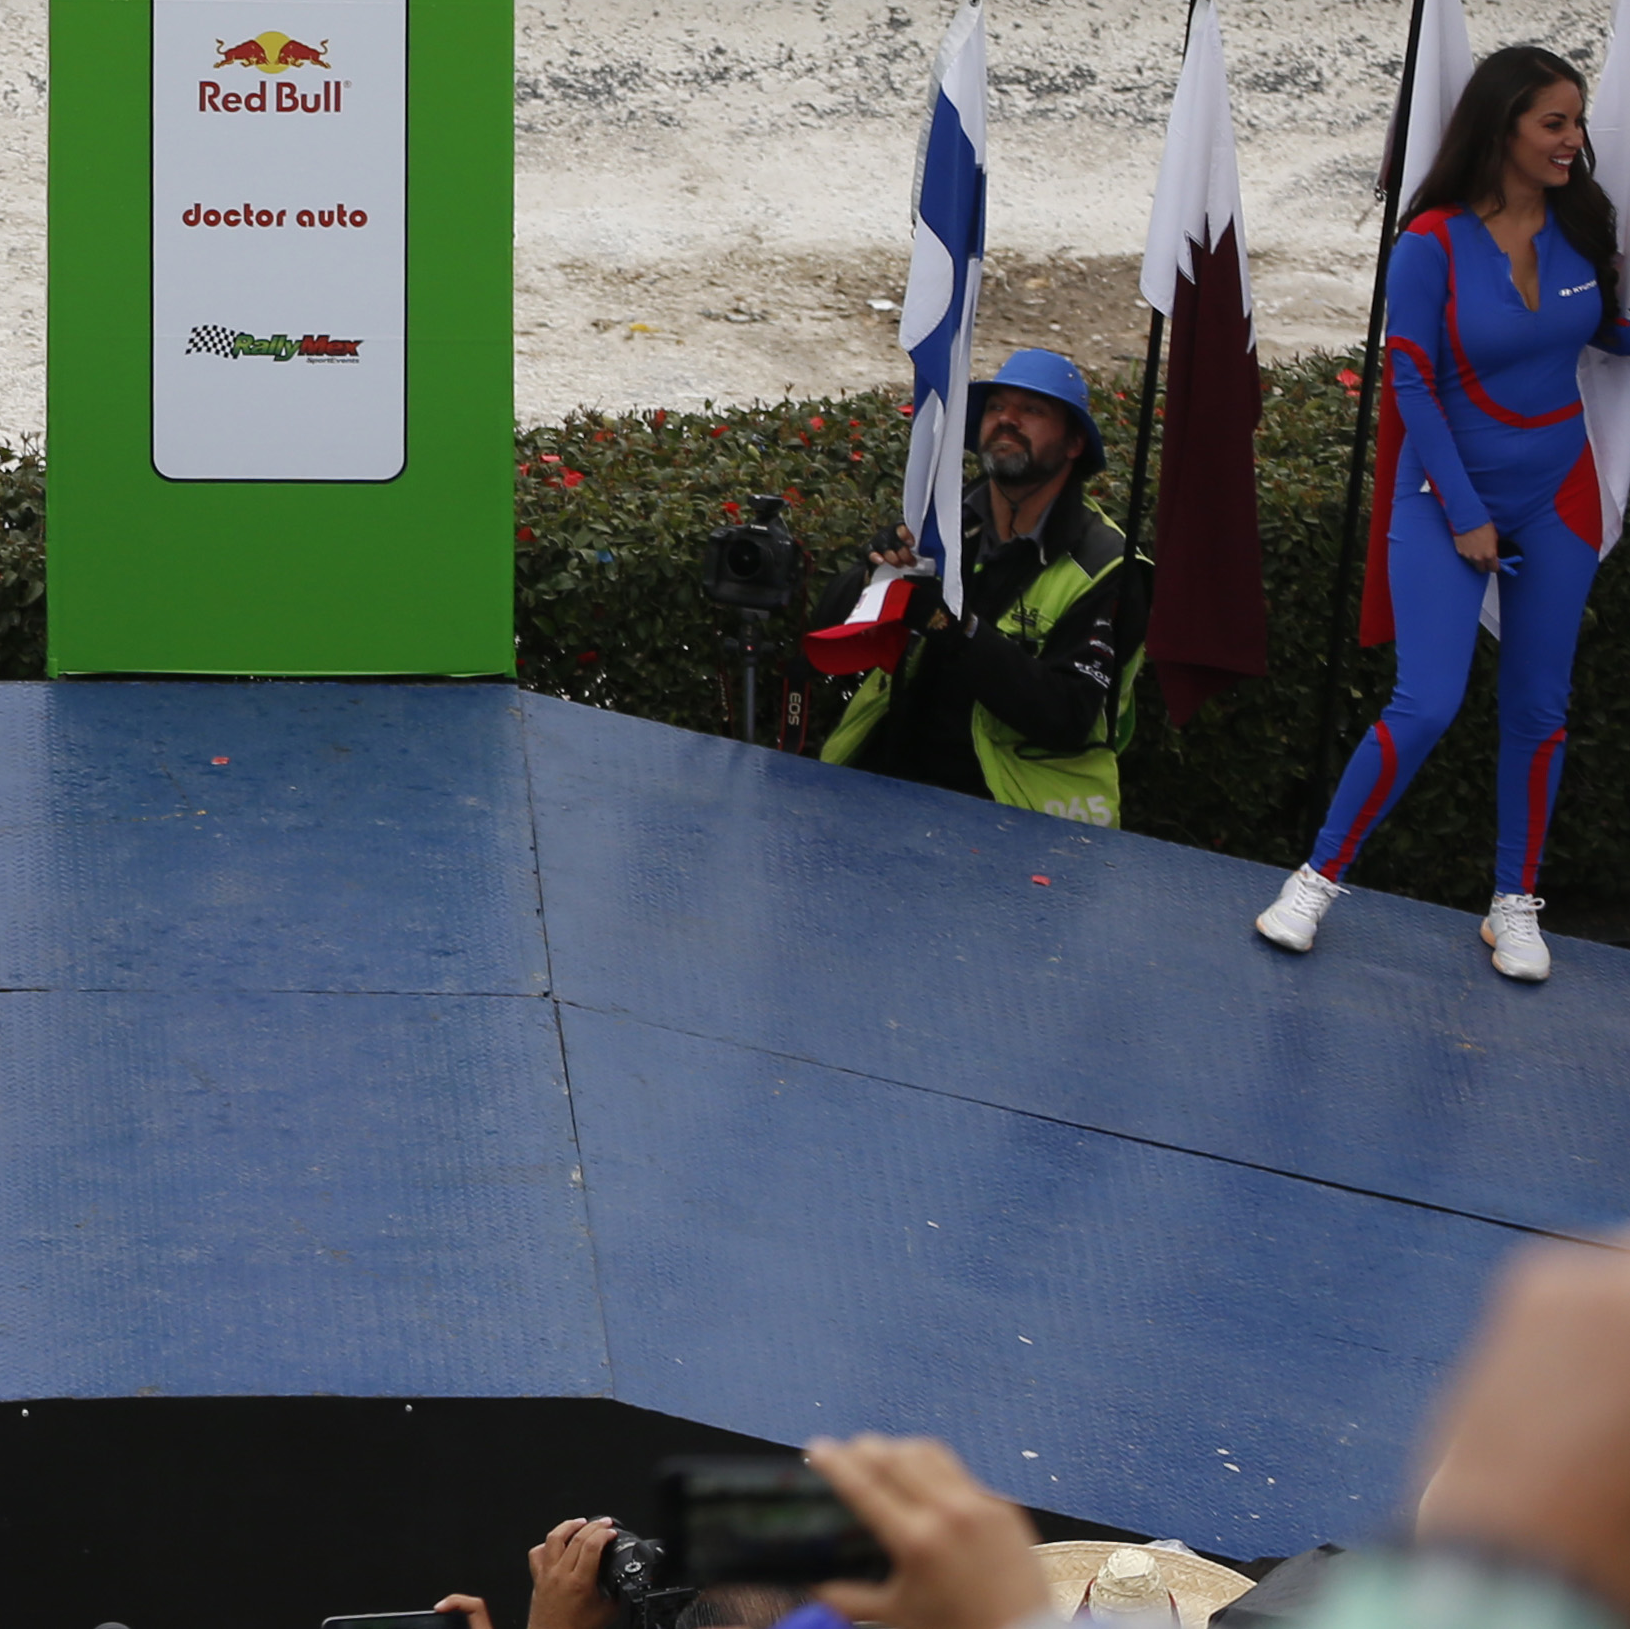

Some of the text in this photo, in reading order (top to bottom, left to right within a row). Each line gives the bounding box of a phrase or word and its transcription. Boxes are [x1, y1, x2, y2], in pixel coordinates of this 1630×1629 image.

[198, 80, 342, 113] Red Bull
[182, 203, 369, 229] doctor auto
